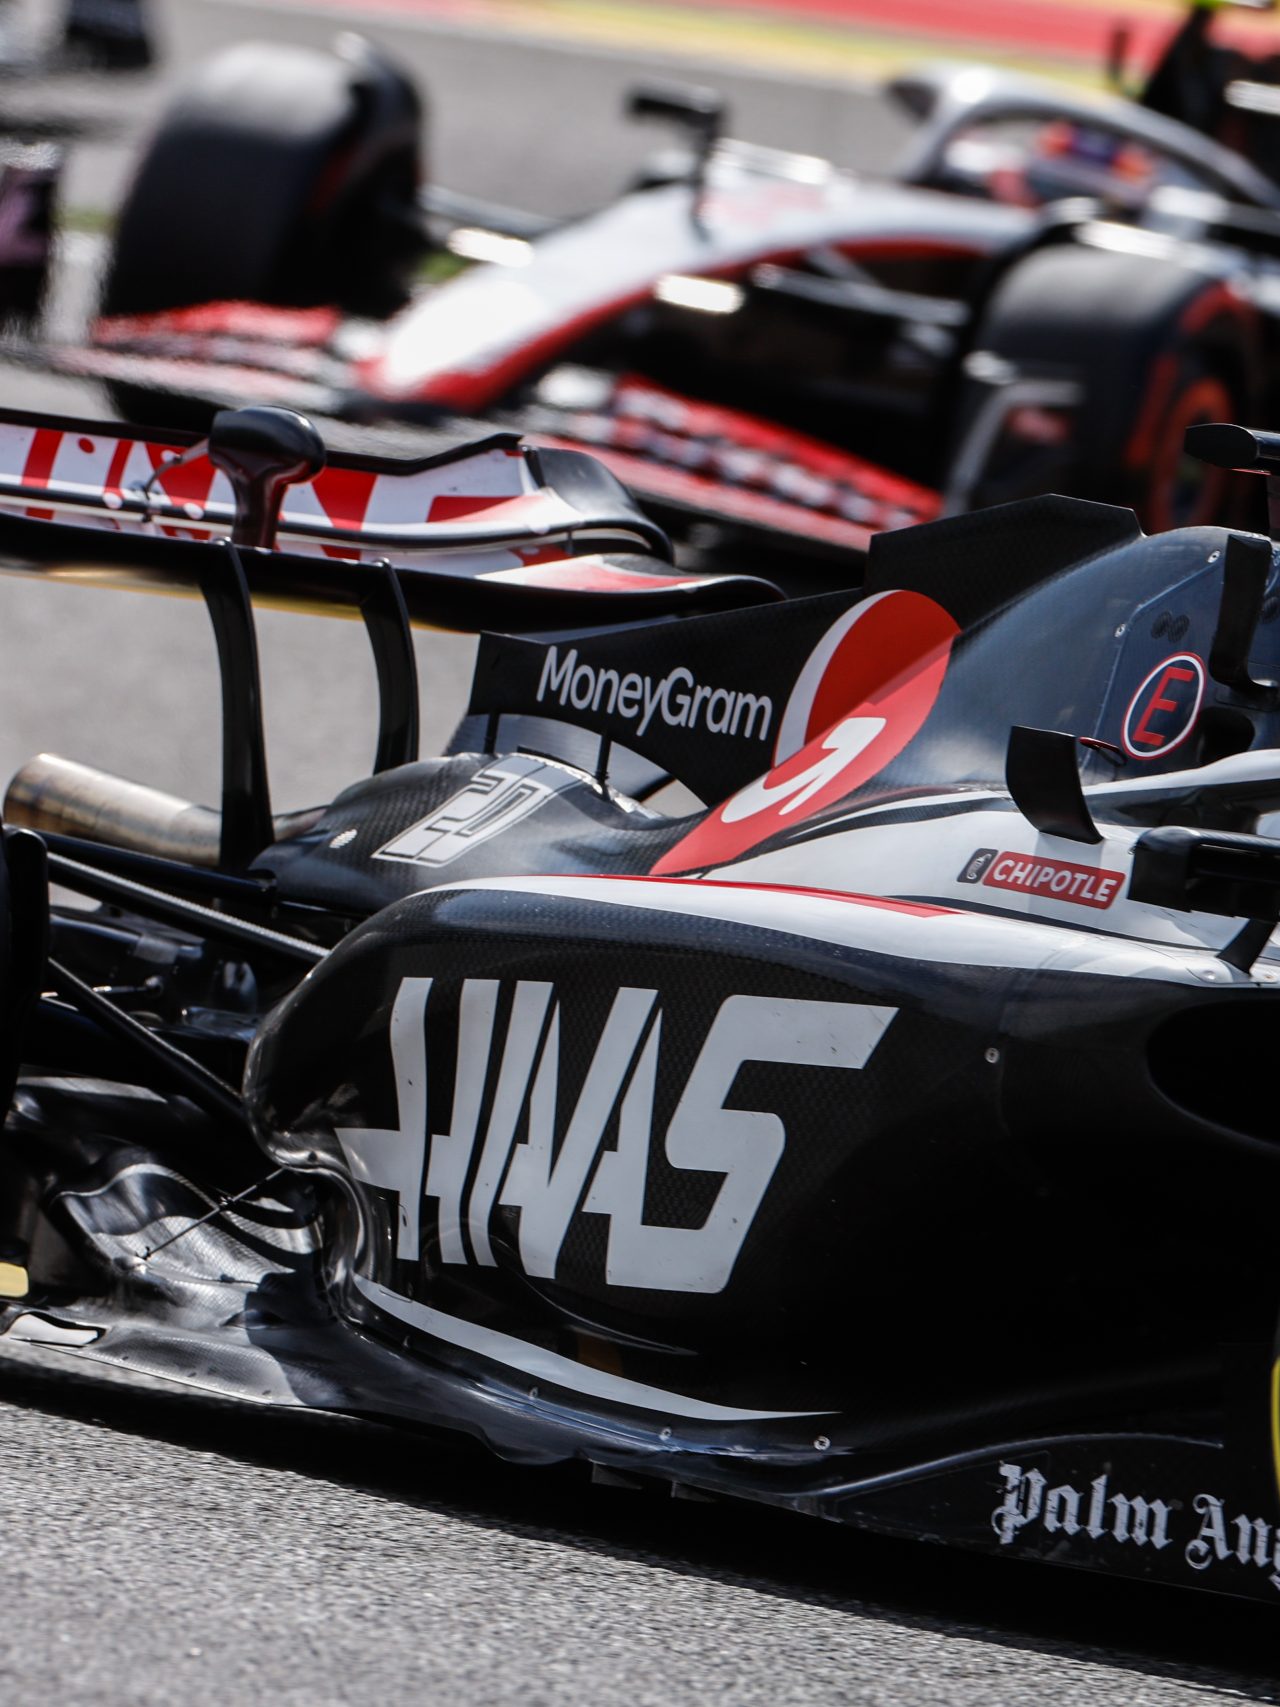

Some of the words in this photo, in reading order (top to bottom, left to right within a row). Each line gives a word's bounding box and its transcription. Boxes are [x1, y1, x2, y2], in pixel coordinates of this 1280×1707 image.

[536, 645, 773, 741] MoneyGram
[1132, 666, 1196, 747] E
[992, 859, 1119, 903] CHIPOTLE
[333, 977, 900, 1295] HAAS
[991, 1460, 1174, 1550] Palm
